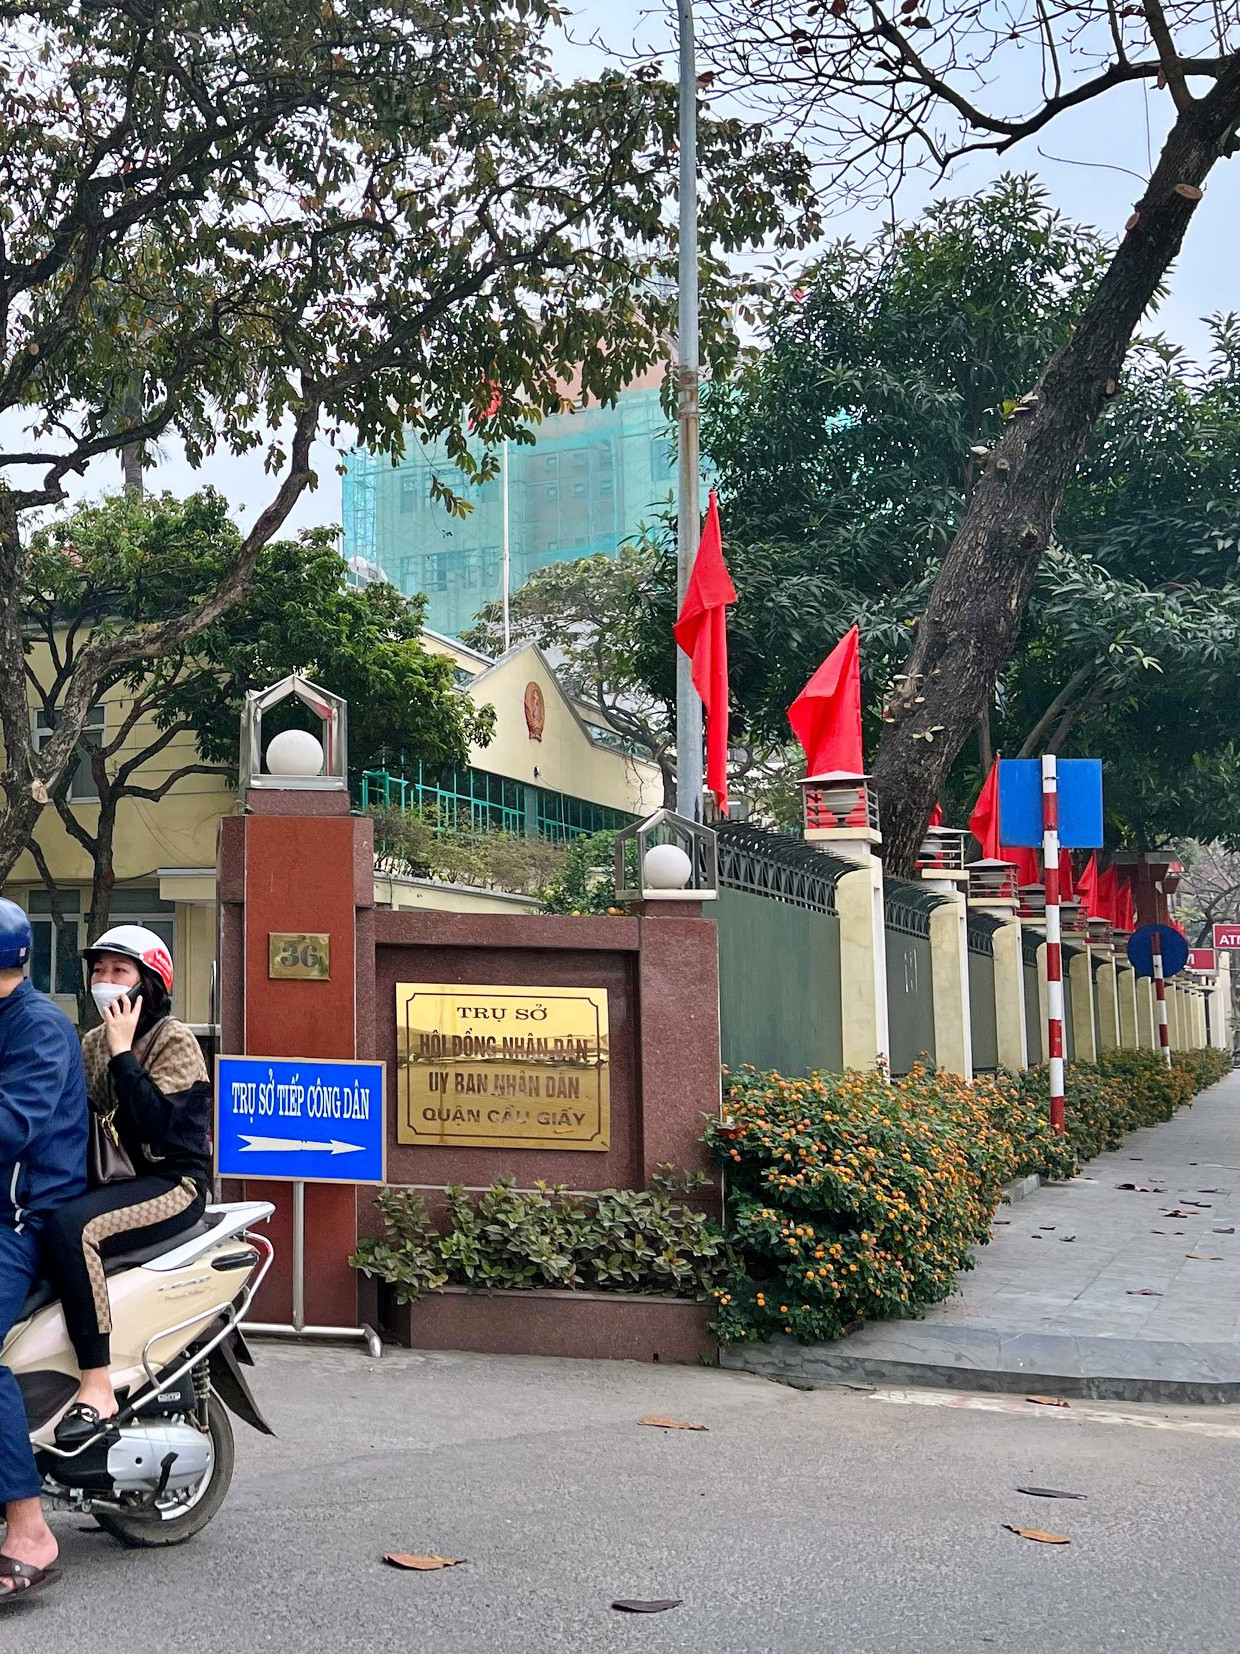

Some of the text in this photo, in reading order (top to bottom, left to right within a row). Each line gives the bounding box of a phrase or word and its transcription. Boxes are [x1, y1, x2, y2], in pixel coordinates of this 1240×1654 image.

[1220, 934, 1240, 945] AT
[280, 944, 319, 968] 36
[456, 1003, 548, 1023] TRỤ SỞ
[452, 1027, 497, 1059] ĐỒNG
[502, 1032, 548, 1059] NHÂN
[554, 1033, 588, 1061] DÂN
[231, 1068, 370, 1124] TRỤ SỞ TIẾP CÔNG DÂN
[454, 1072, 489, 1095] BAN
[493, 1070, 540, 1098] NHÂN
[546, 1072, 580, 1099] DÂN
[422, 1105, 587, 1126] QUẬN CẦU GIẤY
